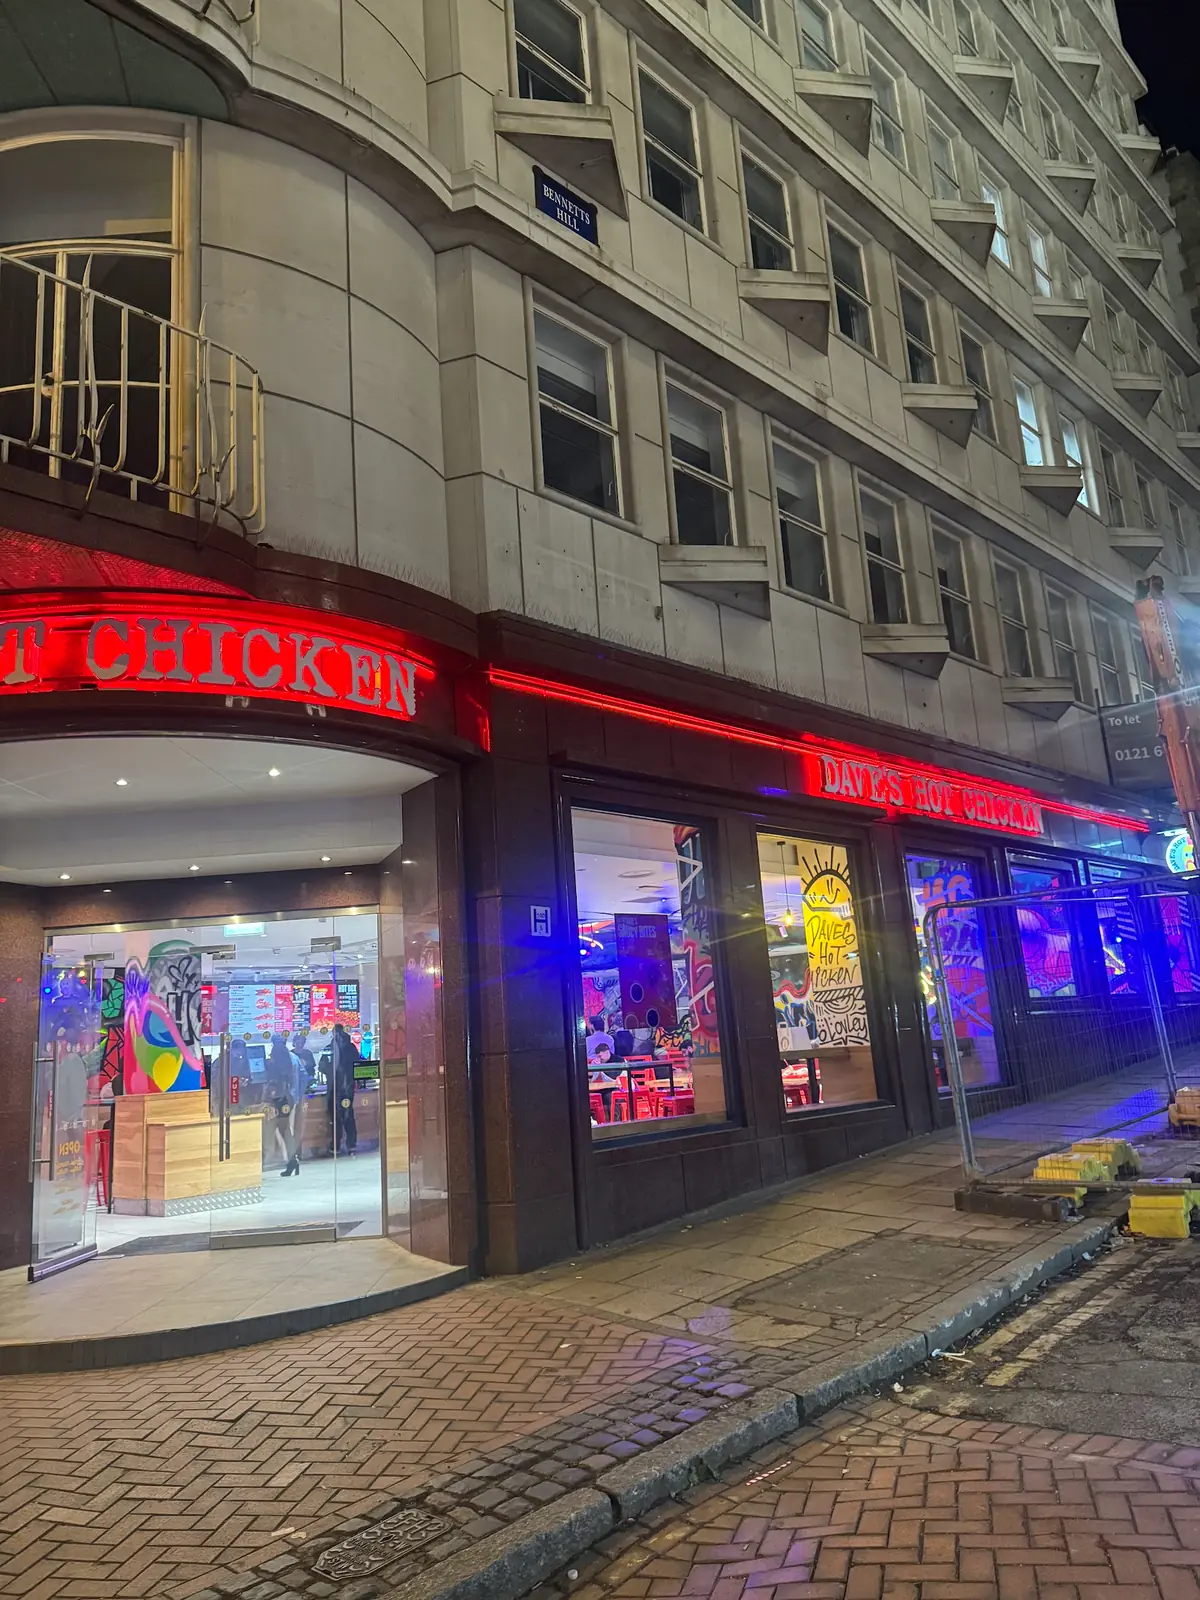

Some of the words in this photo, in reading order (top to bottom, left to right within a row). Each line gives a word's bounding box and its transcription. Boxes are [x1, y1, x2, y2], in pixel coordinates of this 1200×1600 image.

[543, 184, 590, 225] BENNETTS
[557, 207, 579, 231] HILL
[88, 617, 416, 716] CHICKEN
[1108, 717, 1122, 727] To
[1124, 714, 1141, 726] let
[1115, 747, 1150, 761] 0121
[820, 755, 903, 806] DAVE'S
[911, 775, 953, 816] HOT
[961, 787, 1045, 833] CHICKEN
[1172, 837, 1186, 849] HOT
[639, 925, 656, 938] BITES
